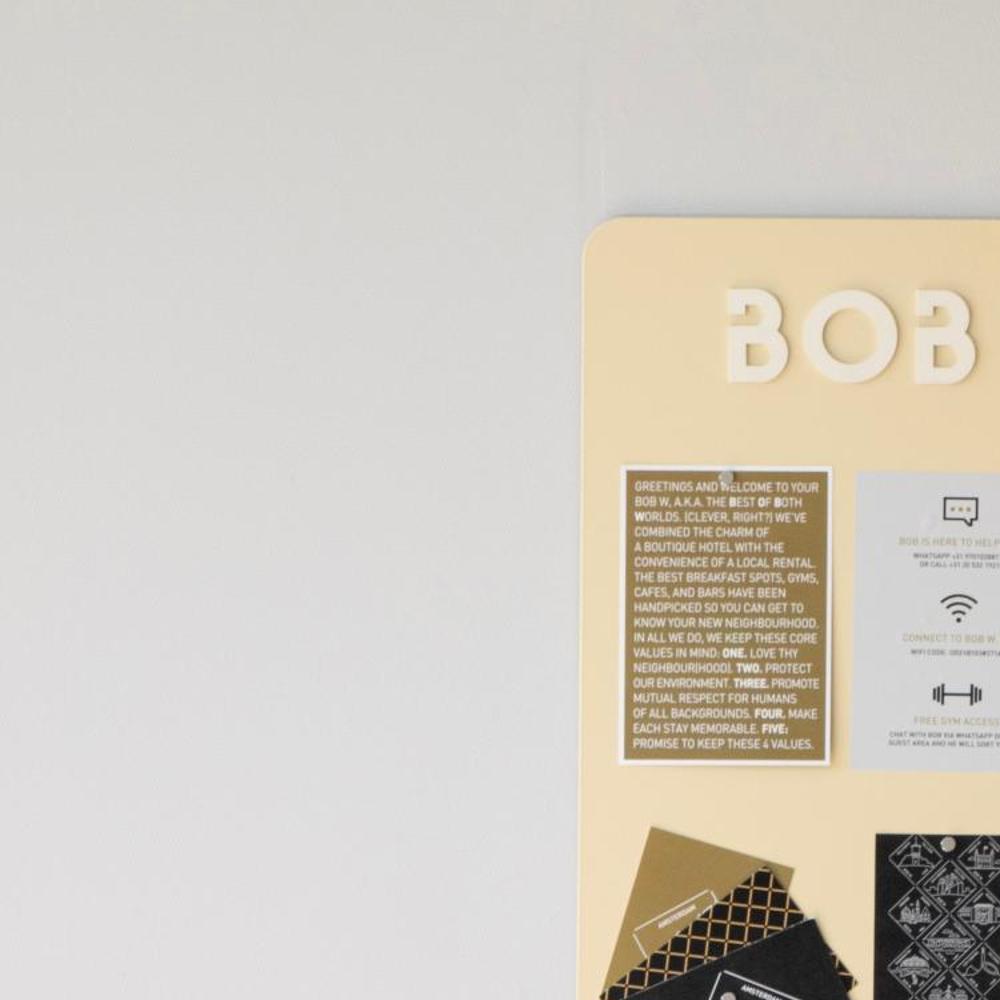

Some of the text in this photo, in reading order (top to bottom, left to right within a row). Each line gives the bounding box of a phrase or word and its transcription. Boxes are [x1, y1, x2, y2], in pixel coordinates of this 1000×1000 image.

[727, 288, 977, 384] BOB
[634, 482, 693, 492] GREETINGS
[696, 482, 719, 492] AND
[775, 482, 789, 492] TO
[790, 482, 819, 492] YOUR
[634, 496, 657, 508] BOB
[706, 496, 728, 508] THE
[729, 496, 756, 508] BEST
[757, 496, 771, 508] OF
[774, 496, 803, 508] BOTH
[634, 526, 770, 538] COMBINED THE CHARM OF
[634, 542, 784, 552] A BOUTIQUE HOTEL WITH THE
[898, 536, 918, 547] BOB
[921, 536, 930, 547] IS
[932, 536, 958, 547] HERE
[961, 536, 973, 547] TO
[975, 536, 1000, 547] HELP
[634, 556, 709, 568] CONVENIENCE
[710, 556, 725, 568] OF
[727, 556, 734, 568] A
[737, 556, 770, 568] LOCAL
[634, 572, 655, 584] THE
[657, 572, 684, 584] BEST
[686, 572, 747, 584] BREAKFAST
[787, 572, 819, 584] GYMS,
[672, 587, 695, 598] AND
[697, 587, 725, 598] BARS
[727, 587, 756, 598] HAVE
[757, 587, 786, 598] BEEN
[634, 602, 804, 614] HANDPICKED SO YOU CAN GET TO
[634, 617, 666, 628] KNOW
[667, 617, 697, 628] YOUR
[699, 617, 723, 628] NEW
[634, 632, 645, 644] IN
[647, 632, 666, 644] ALL
[668, 632, 685, 644] WE
[706, 632, 723, 644] WE
[724, 632, 753, 644] KEEP
[754, 632, 787, 644] THESE
[790, 632, 818, 644] CORE
[902, 633, 948, 642] CONNECT
[633, 648, 673, 659] VALUES
[675, 648, 687, 659] IN
[722, 648, 748, 659] ONE.
[750, 648, 777, 659] LOVE
[778, 648, 798, 659] THY
[735, 662, 762, 674] TWO.
[765, 662, 812, 674] PROTECT
[633, 678, 654, 690] OUR
[771, 678, 820, 690] PROMOTE
[633, 692, 798, 704] MUTUAL RESPECT FOR HUMANS
[633, 708, 647, 720] OF
[648, 708, 668, 720] ALL
[754, 708, 786, 720] FOUR.
[788, 708, 818, 720] MAKE
[914, 716, 1000, 726] FREE GYM ACCESS
[633, 722, 661, 734] EACH
[663, 722, 689, 734] STAY
[633, 738, 679, 750] PROMISE
[681, 738, 695, 750] TO
[697, 738, 725, 750] KEEP
[727, 738, 761, 750] THESE
[770, 738, 814, 750] VALUES.
